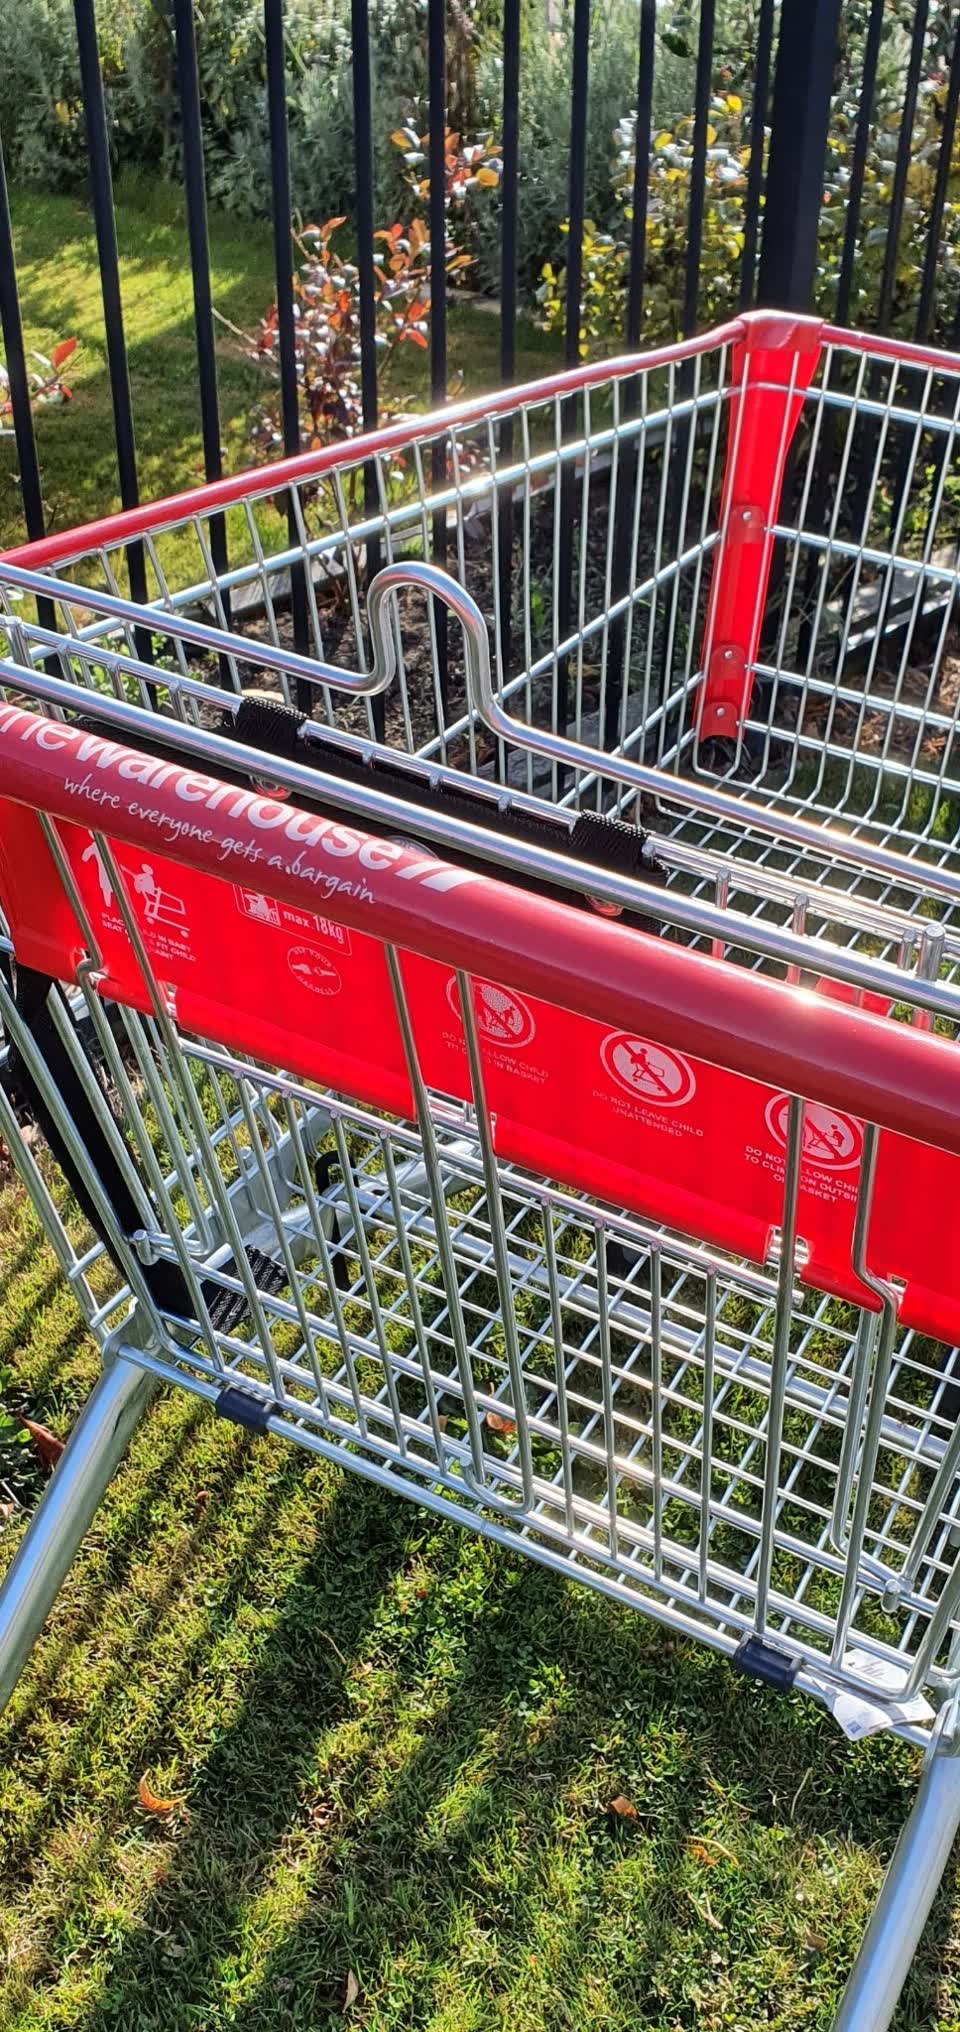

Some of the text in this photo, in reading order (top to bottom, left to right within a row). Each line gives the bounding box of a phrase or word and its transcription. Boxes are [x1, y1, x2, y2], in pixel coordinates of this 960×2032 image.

[64, 772, 376, 904] where everyone gets a bargain
[312, 915, 344, 944] 18kg
[170, 946, 197, 962] CHILD
[592, 1090, 704, 1137] DO NOT LEAVE CHILD
[613, 1106, 683, 1137] UNATTENDED
[744, 1153, 760, 1165] TO
[745, 1145, 763, 1157] DO
